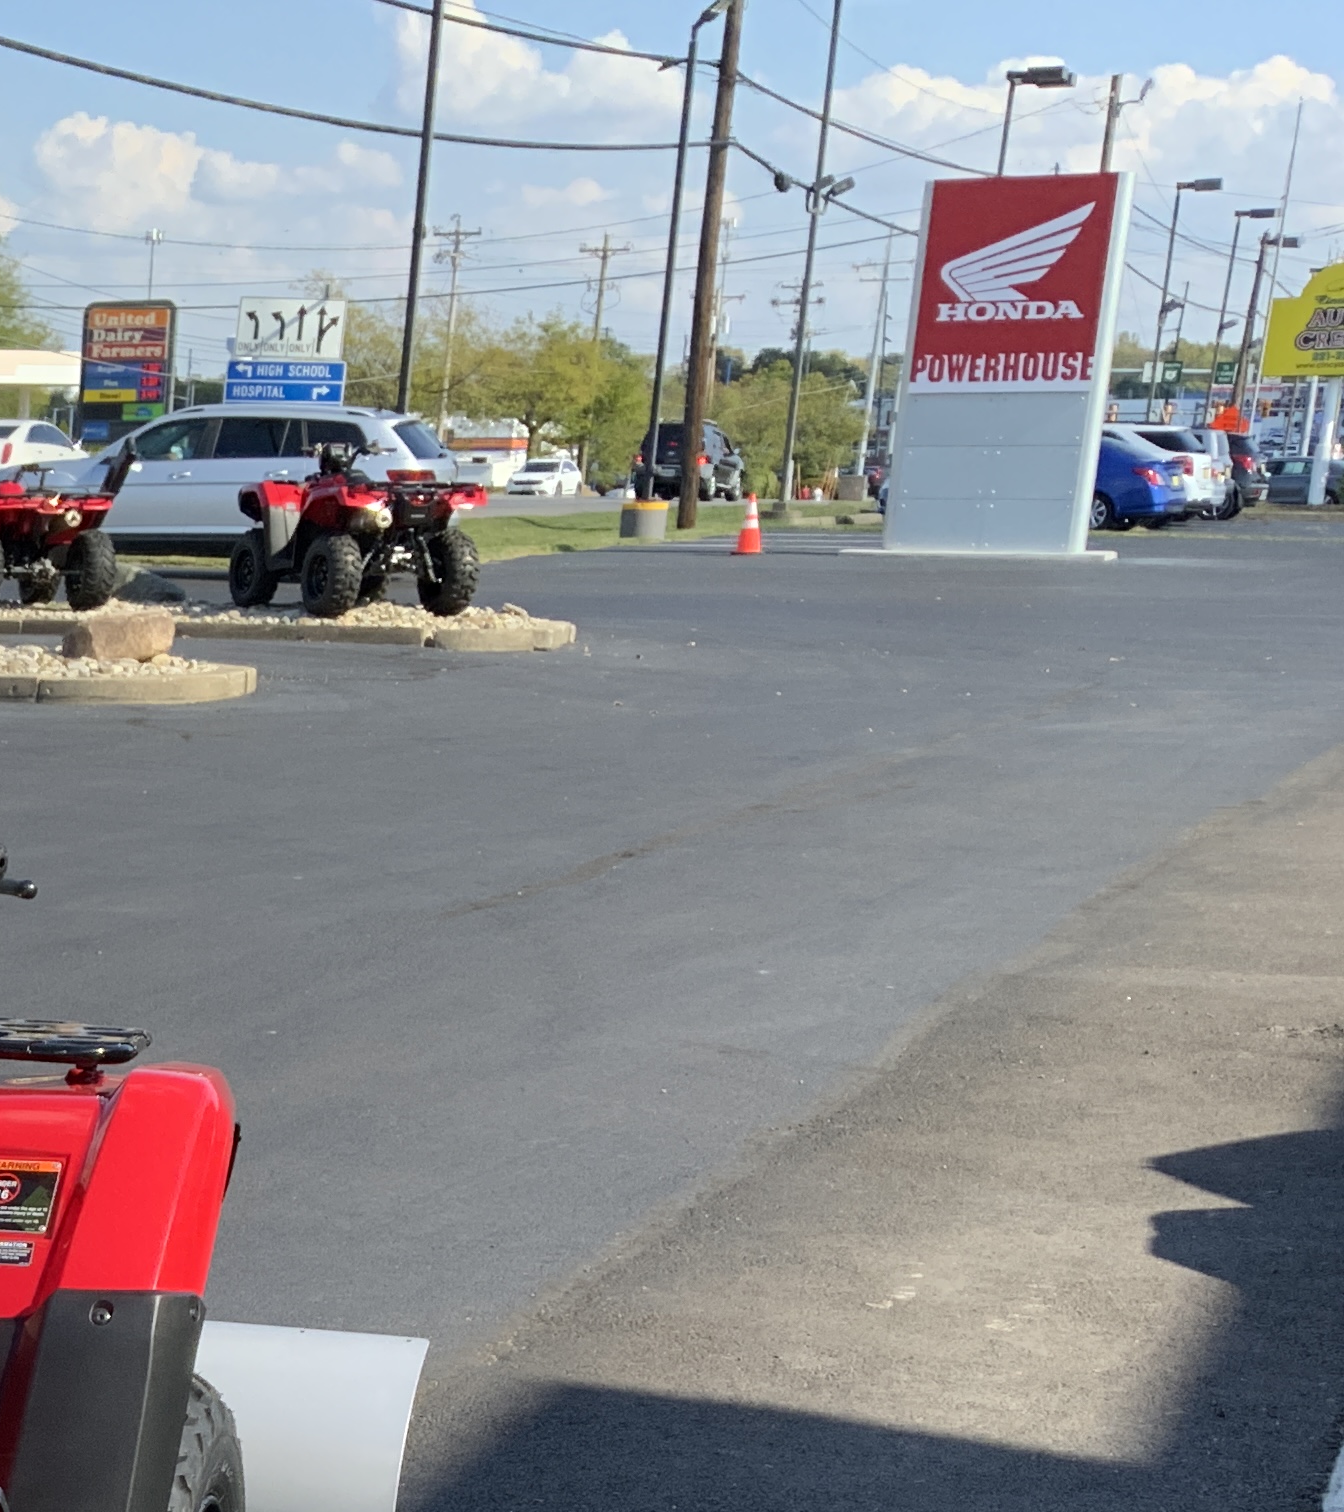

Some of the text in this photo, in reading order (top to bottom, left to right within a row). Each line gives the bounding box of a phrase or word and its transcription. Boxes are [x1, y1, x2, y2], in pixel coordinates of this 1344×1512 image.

[935, 300, 1085, 323] HONDA
[1306, 308, 1344, 328] AU
[93, 312, 156, 326] United
[92, 328, 144, 343] Dairy
[92, 345, 163, 358] Farmers
[237, 342, 261, 352] ONLY
[263, 342, 285, 352] ONLY
[289, 343, 311, 352] ONLY
[256, 364, 332, 378] HIGH SCHOOL
[910, 352, 1095, 383] POWERHOUSE
[232, 385, 285, 398] HOSPITAL
